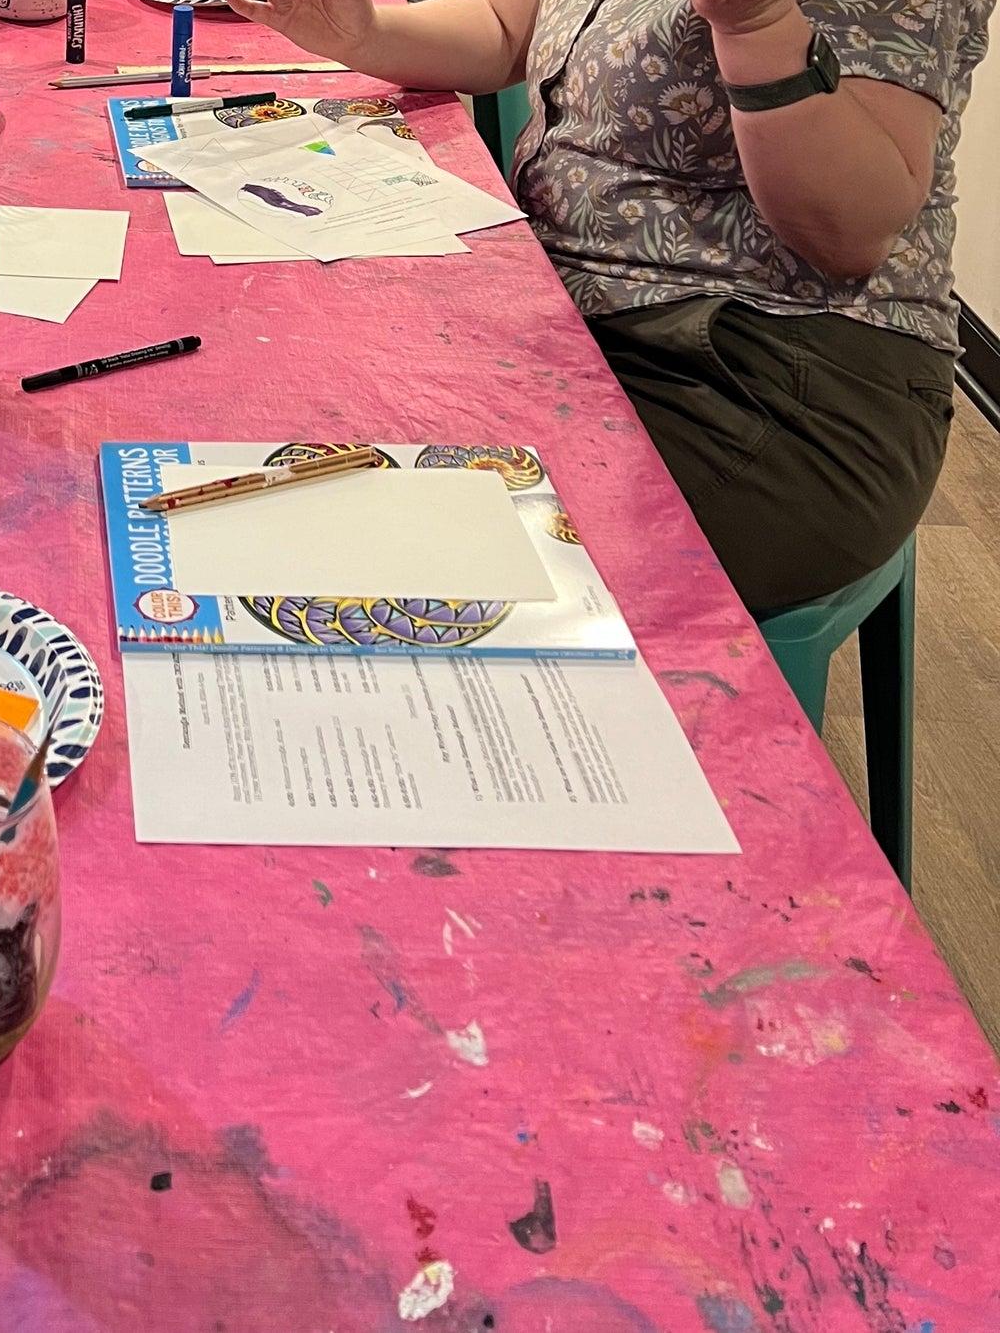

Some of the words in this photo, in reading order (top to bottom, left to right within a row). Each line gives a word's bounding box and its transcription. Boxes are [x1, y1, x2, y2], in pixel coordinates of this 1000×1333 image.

[118, 448, 161, 519] PATTERNS
[128, 523, 168, 584] DOODLE
[151, 592, 166, 619] COLOR
[167, 593, 184, 618] THIS!
